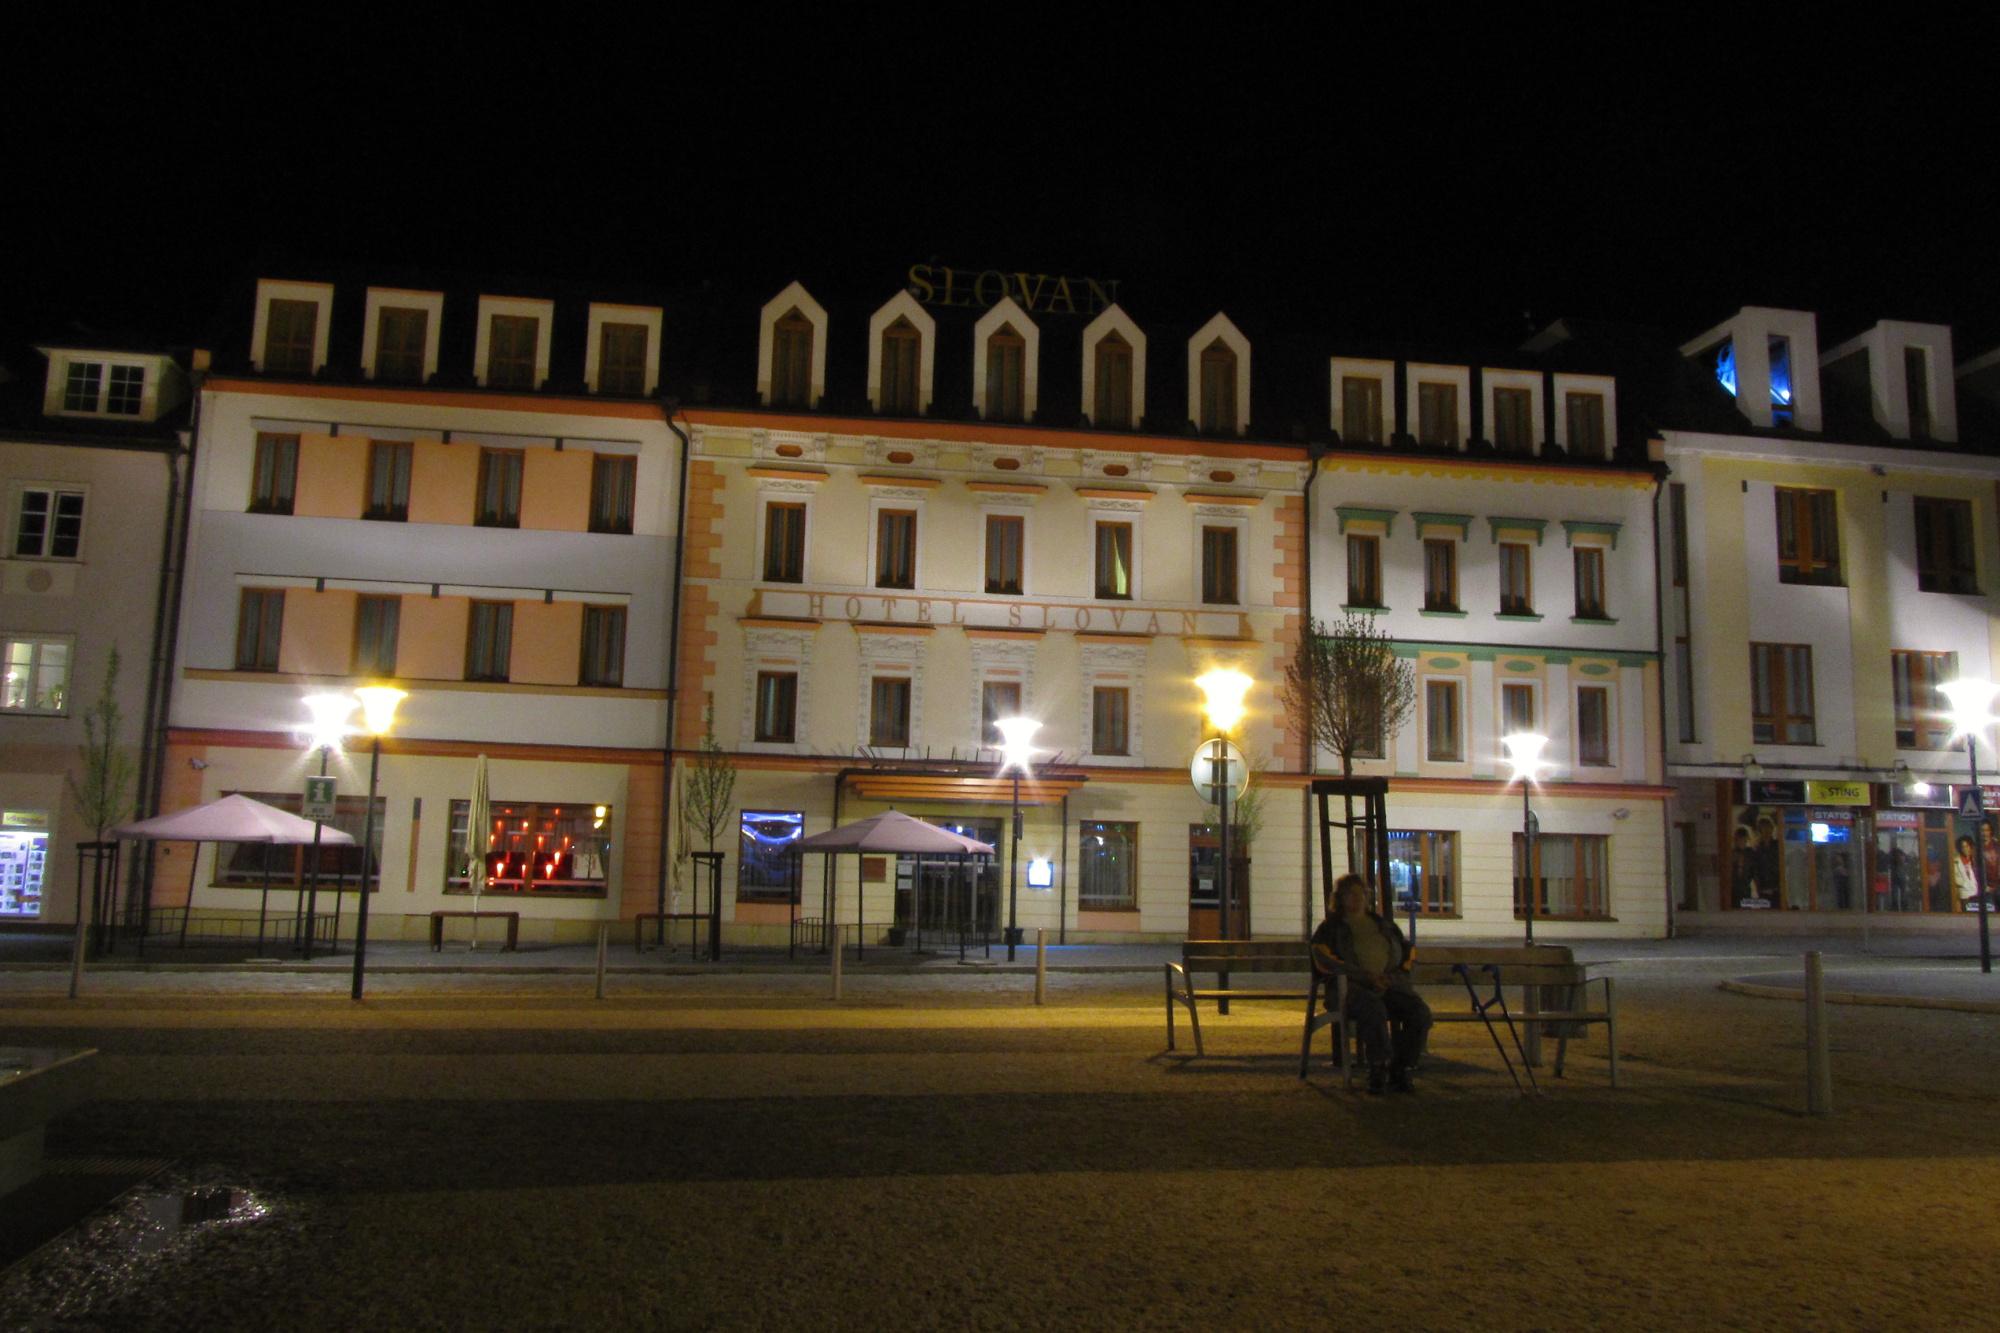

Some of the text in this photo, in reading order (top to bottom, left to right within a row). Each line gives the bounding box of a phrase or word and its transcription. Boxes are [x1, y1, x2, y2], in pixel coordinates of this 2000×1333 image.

[907, 262, 1122, 315] SLOVAN
[808, 594, 1197, 635] HOTEL SLOVAN
